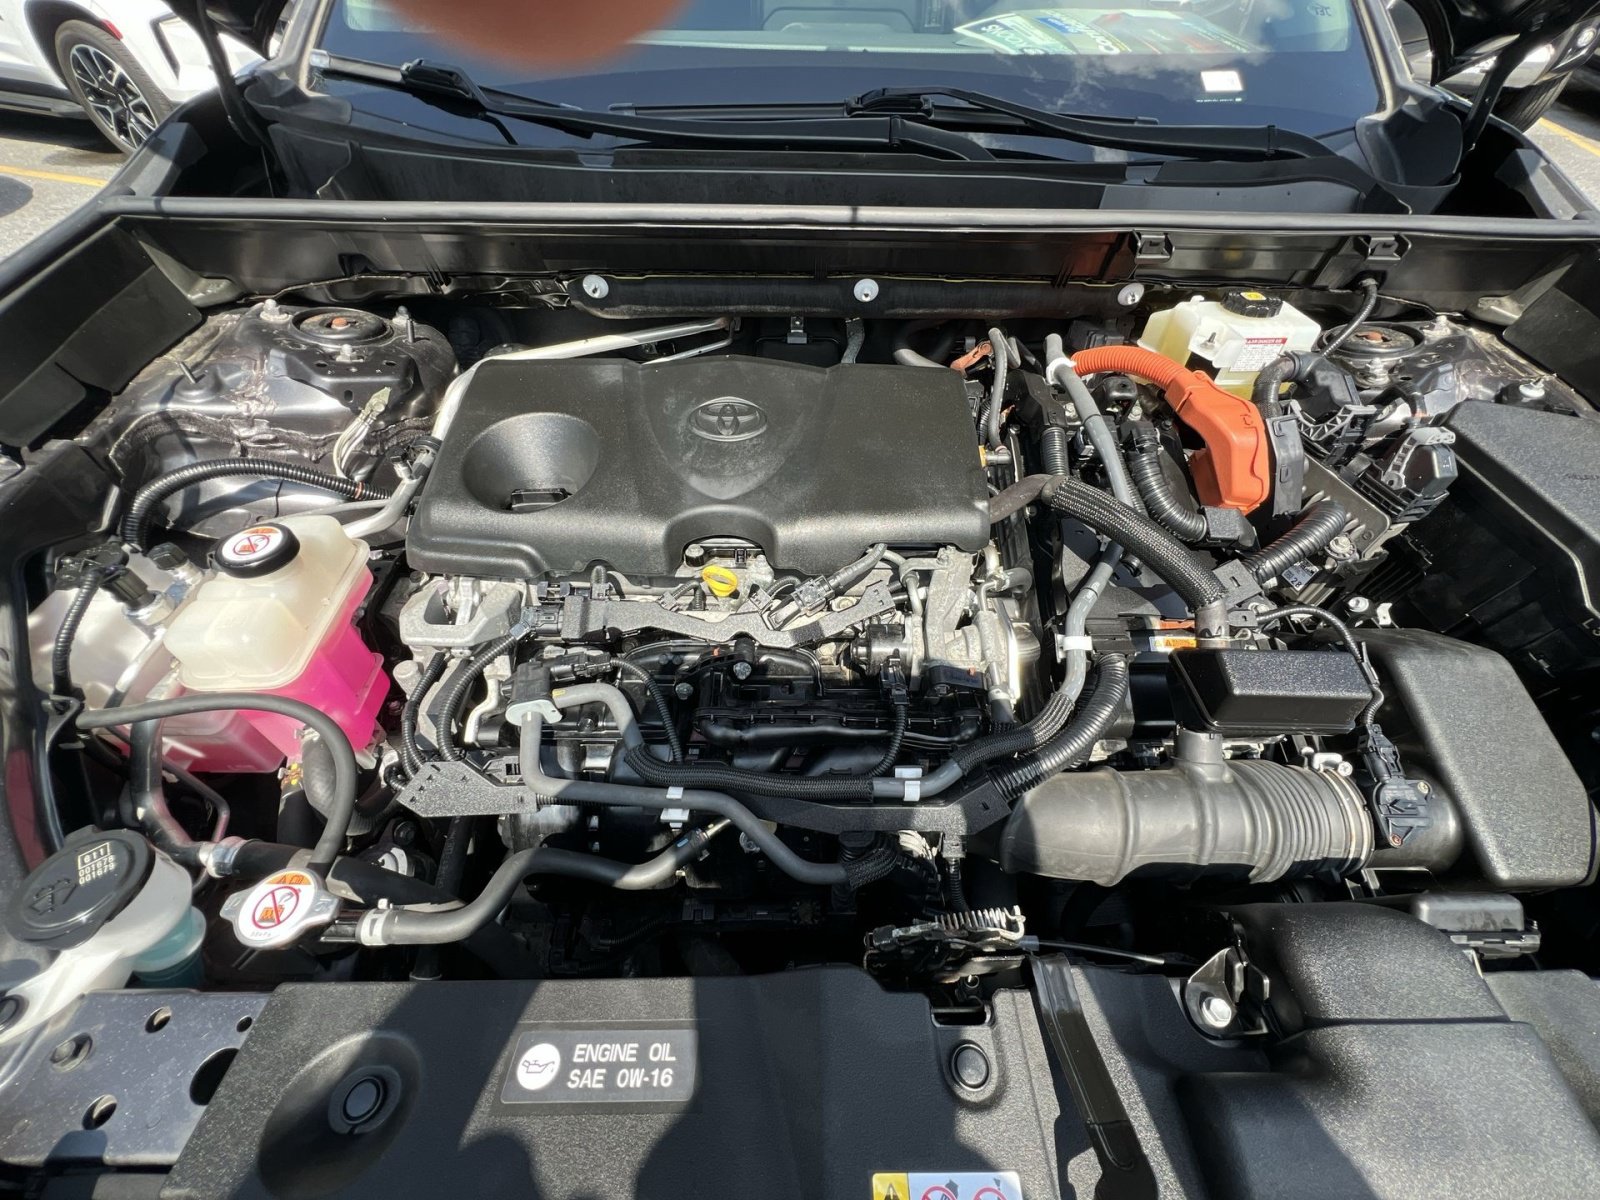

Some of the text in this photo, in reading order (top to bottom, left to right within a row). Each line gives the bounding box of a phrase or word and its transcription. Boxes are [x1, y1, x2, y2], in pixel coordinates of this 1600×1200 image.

[79, 855, 114, 877] 001678
[79, 862, 114, 885] 001679
[573, 1043, 676, 1062] ENGINE OIL
[567, 1068, 674, 1088] SAE 0W-16
